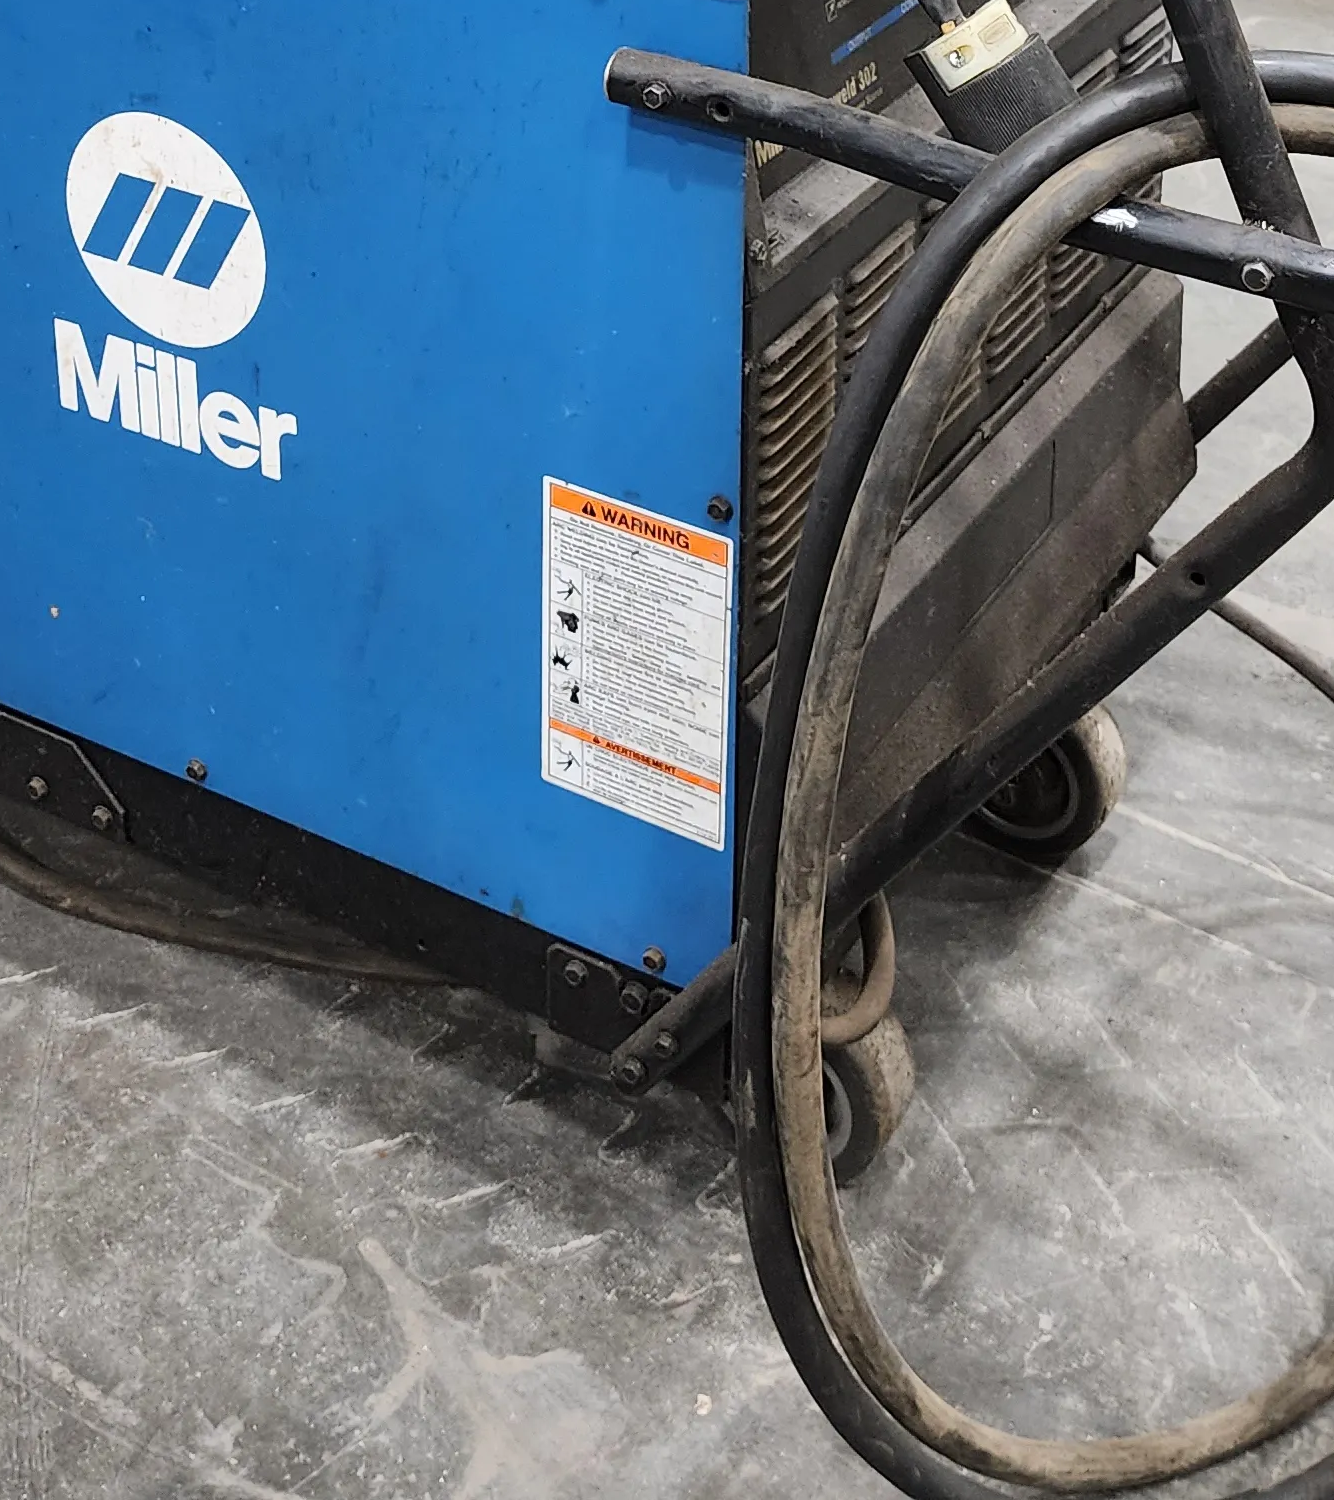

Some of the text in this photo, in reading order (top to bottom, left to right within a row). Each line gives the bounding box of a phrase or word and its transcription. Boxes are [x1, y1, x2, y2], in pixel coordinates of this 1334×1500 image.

[857, 61, 878, 91] 302
[53, 316, 298, 482] Miller
[600, 504, 690, 551] WARNING
[605, 741, 677, 776] AVERTISSEMENT
